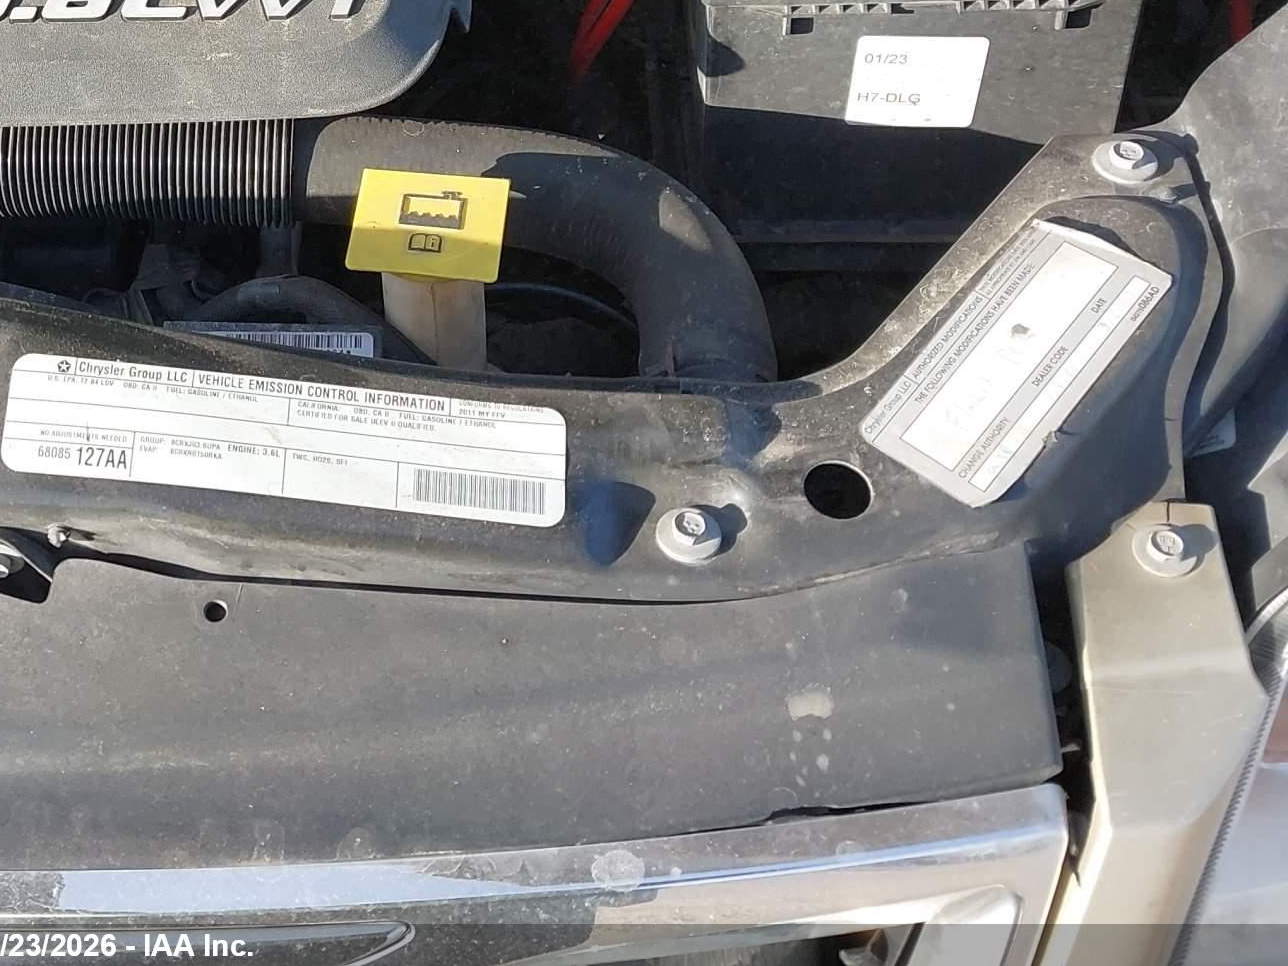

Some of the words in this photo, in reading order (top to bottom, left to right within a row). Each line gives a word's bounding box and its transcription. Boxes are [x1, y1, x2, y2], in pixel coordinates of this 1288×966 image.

[864, 53, 909, 65] 01/23
[1090, 298, 1107, 312] DATE
[915, 392, 927, 403] THE
[924, 356, 956, 392] FOLLOWING
[953, 310, 994, 356] MODIFICATIONS
[990, 295, 1007, 311] HAVE
[1003, 280, 1020, 295] BEEN
[1031, 364, 1053, 385] DEALER
[1049, 345, 1068, 363] CODE
[78, 361, 127, 378] Chrysler
[128, 366, 165, 382] Group
[167, 370, 187, 382] LLC
[197, 373, 243, 389] VEHICLE
[248, 378, 302, 395] EMISSION
[307, 385, 359, 402] CONTROL
[364, 391, 445, 411] INFORMATION
[37, 445, 71, 460] 68085
[75, 445, 129, 470] 127AA
[227, 444, 259, 455] ENGINE:
[957, 449, 985, 478] CHANGE
[978, 417, 1011, 450] AUTHORITY
